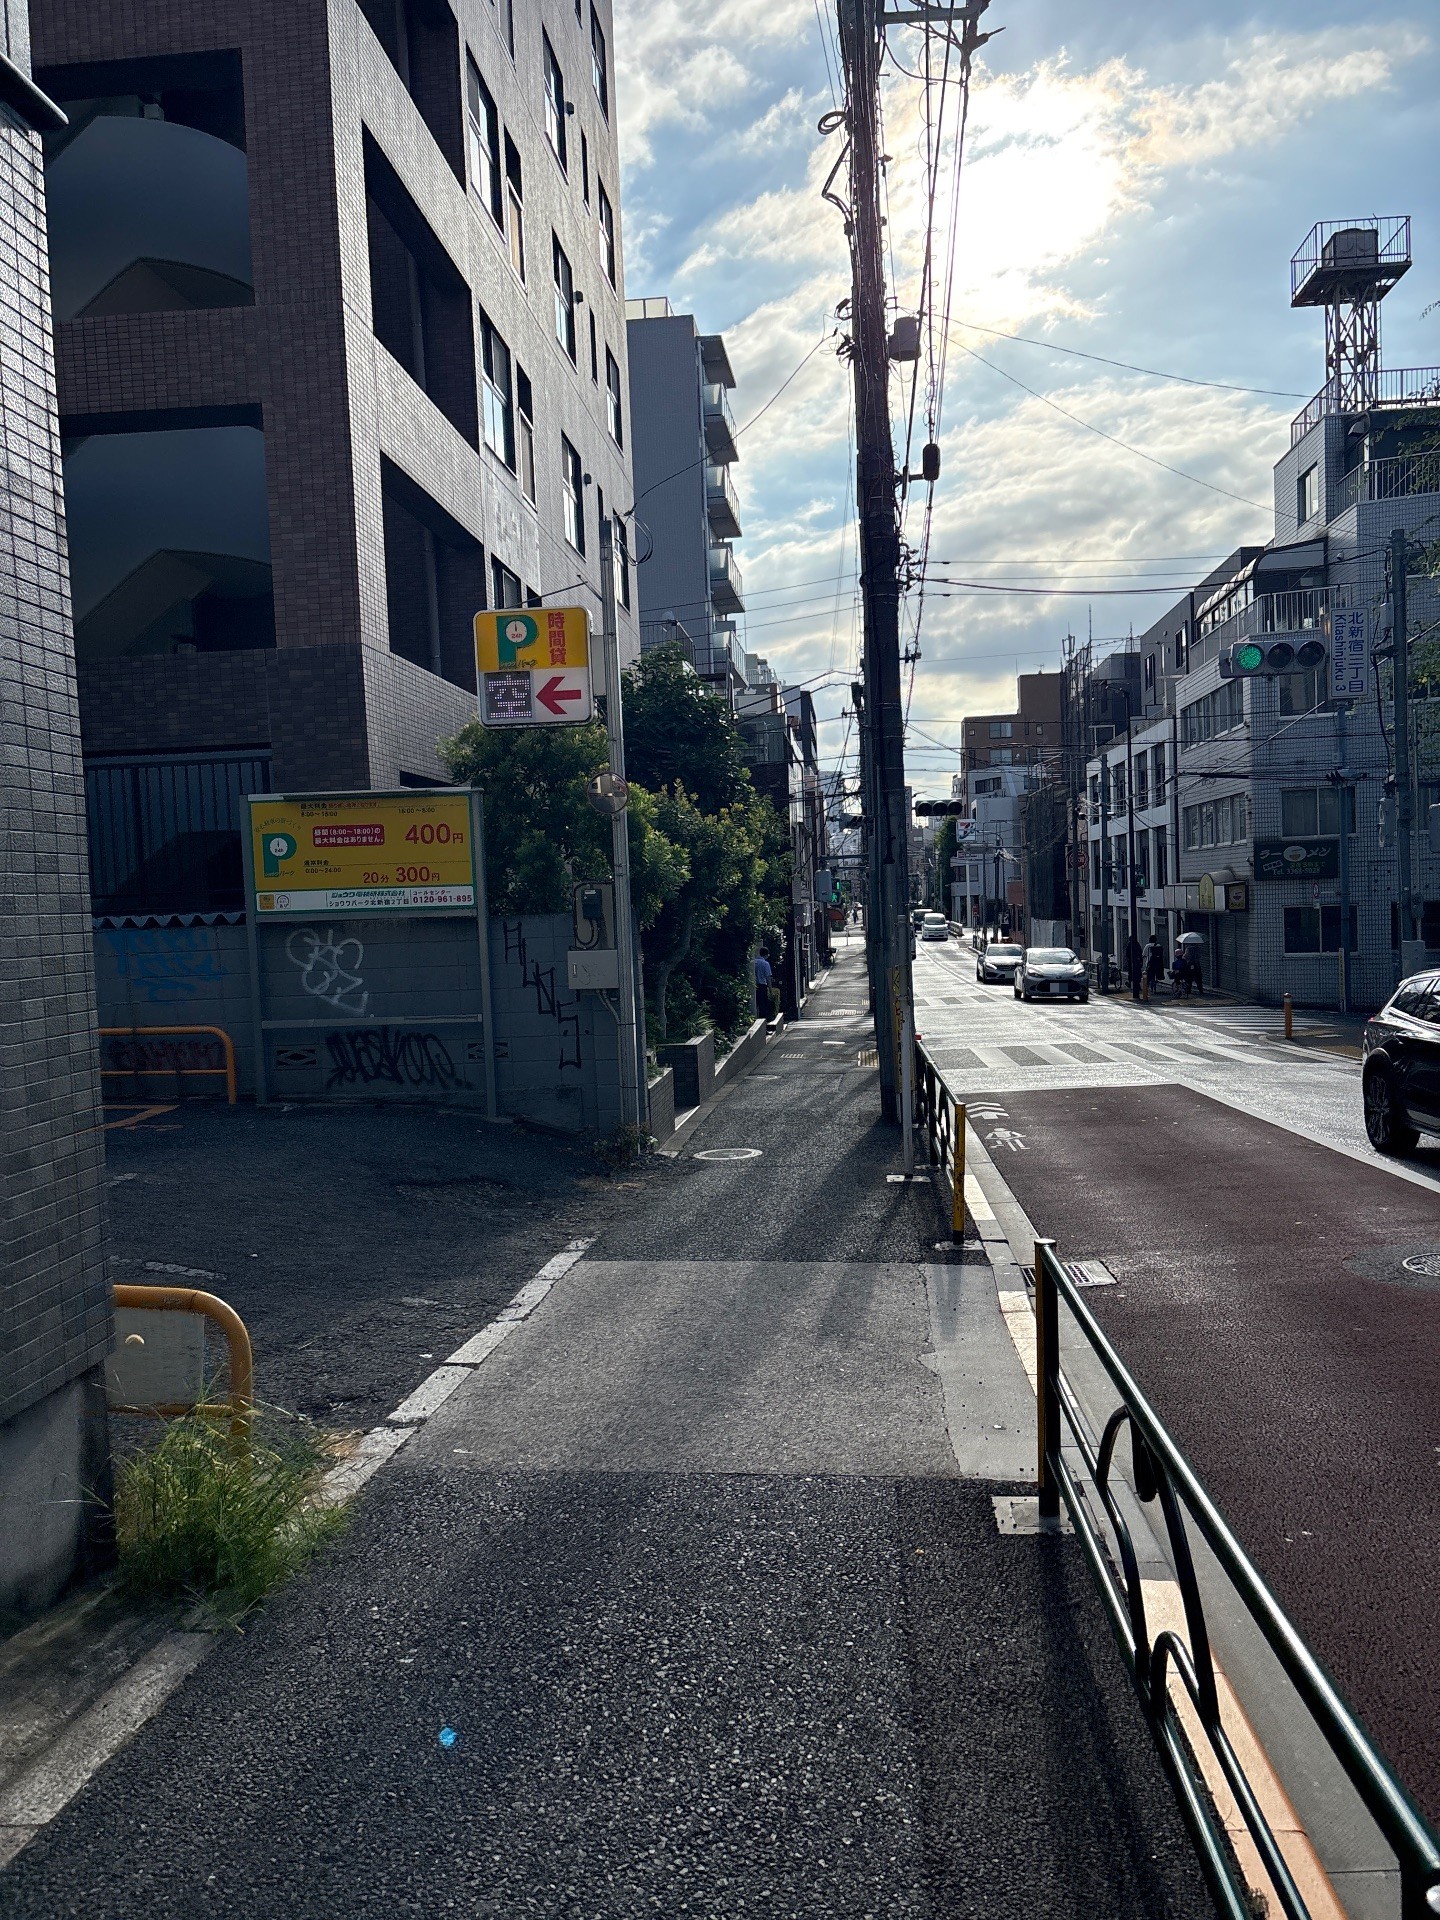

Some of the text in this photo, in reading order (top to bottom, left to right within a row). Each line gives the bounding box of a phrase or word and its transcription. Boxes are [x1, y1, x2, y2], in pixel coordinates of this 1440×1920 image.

[548, 612, 567, 665] 時間貸
[1333, 614, 1346, 681] Kitashinjuku
[1348, 611, 1364, 692] 北新宿三丁目
[488, 675, 532, 718] 空
[405, 823, 463, 845] 400円
[413, 895, 472, 904] 0120-961-895
